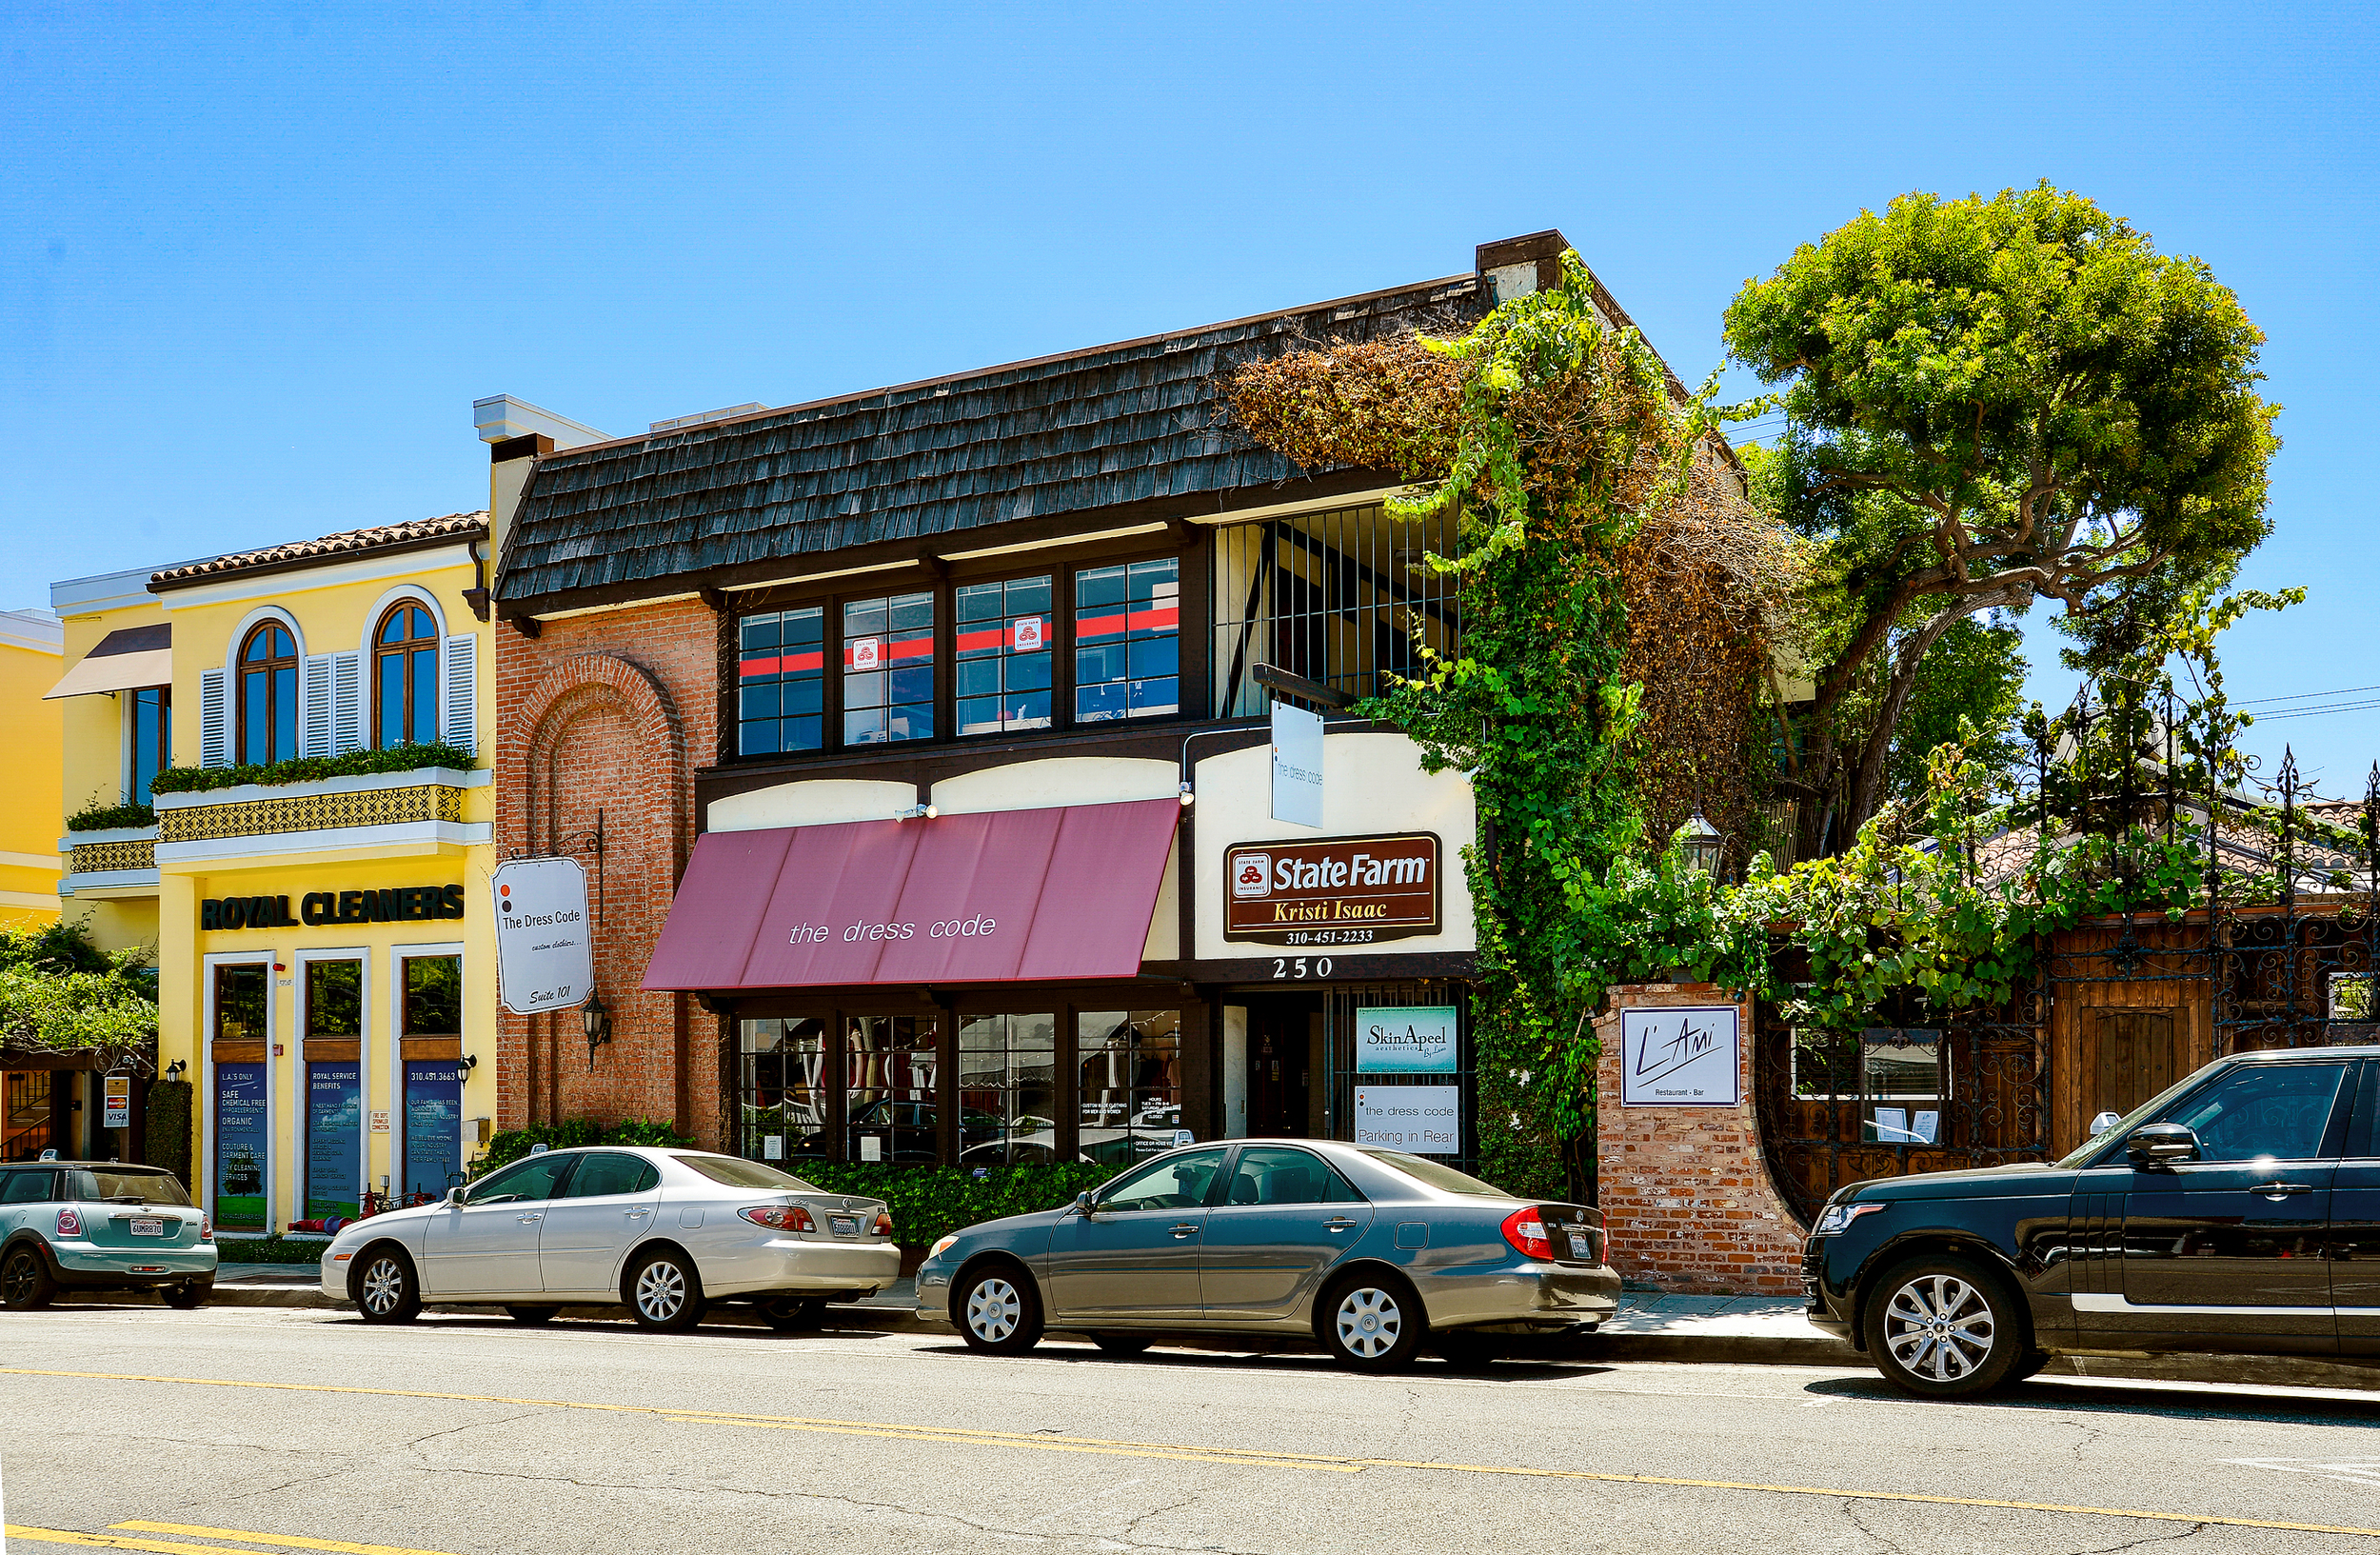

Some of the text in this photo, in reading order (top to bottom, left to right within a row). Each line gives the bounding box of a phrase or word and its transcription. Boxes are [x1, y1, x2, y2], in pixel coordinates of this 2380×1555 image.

[201, 884, 465, 930] ROYAL CLEANERS
[1273, 899, 1387, 922] Kristi Isaac
[503, 909, 581, 930] The Dress Code
[788, 913, 997, 945] the dress code
[1285, 929, 1374, 945] 310-451-2233
[531, 942, 551, 951] custom
[529, 985, 571, 1005] Suite 101
[410, 1072, 456, 1081] 310.451.3663
[222, 1090, 239, 1099] SAFE
[1366, 1106, 1455, 1116] the dress code
[222, 1117, 252, 1126] ORGANIC
[1359, 1129, 1454, 1146] Parking in Rear
